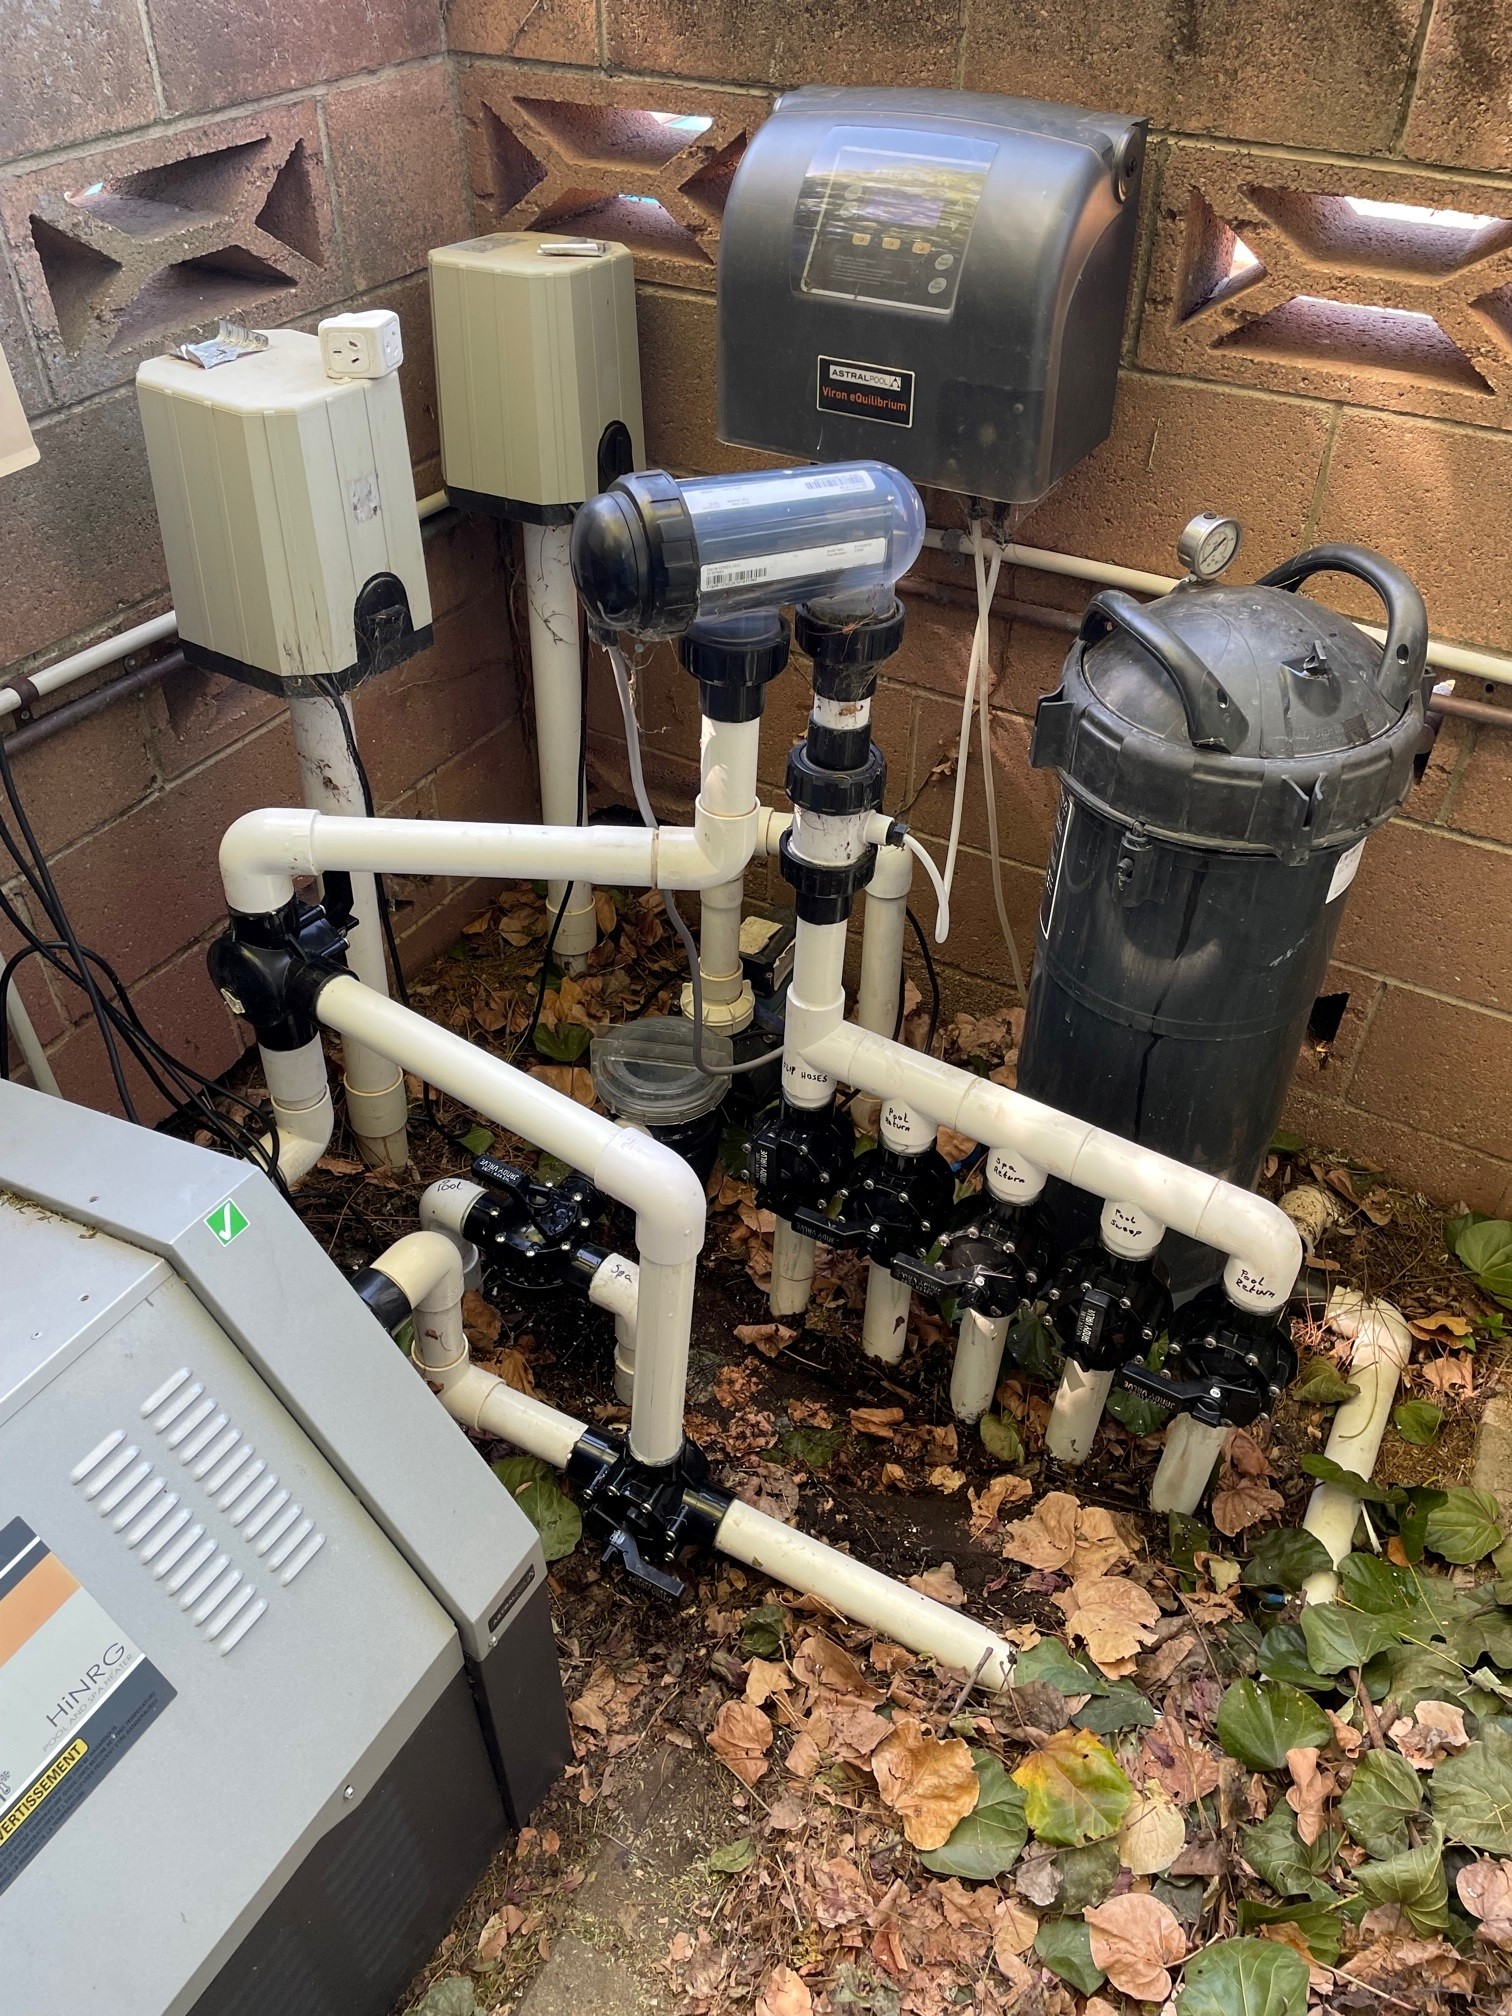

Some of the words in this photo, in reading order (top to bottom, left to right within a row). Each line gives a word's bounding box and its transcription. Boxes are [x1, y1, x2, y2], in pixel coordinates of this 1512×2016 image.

[831, 369, 889, 386] ASTRALPOOL
[822, 385, 848, 401] Viron
[849, 393, 907, 412] eQuilibrium
[479, 1158, 499, 1172] VALVE
[610, 1264, 632, 1283] Spa
[1236, 1278, 1276, 1298] Return
[46, 1642, 126, 1727] HiNRG
[42, 1724, 69, 1752] POOL
[67, 1703, 88, 1726] AND
[87, 1685, 105, 1704] SPA
[103, 1653, 134, 1686] HEATER
